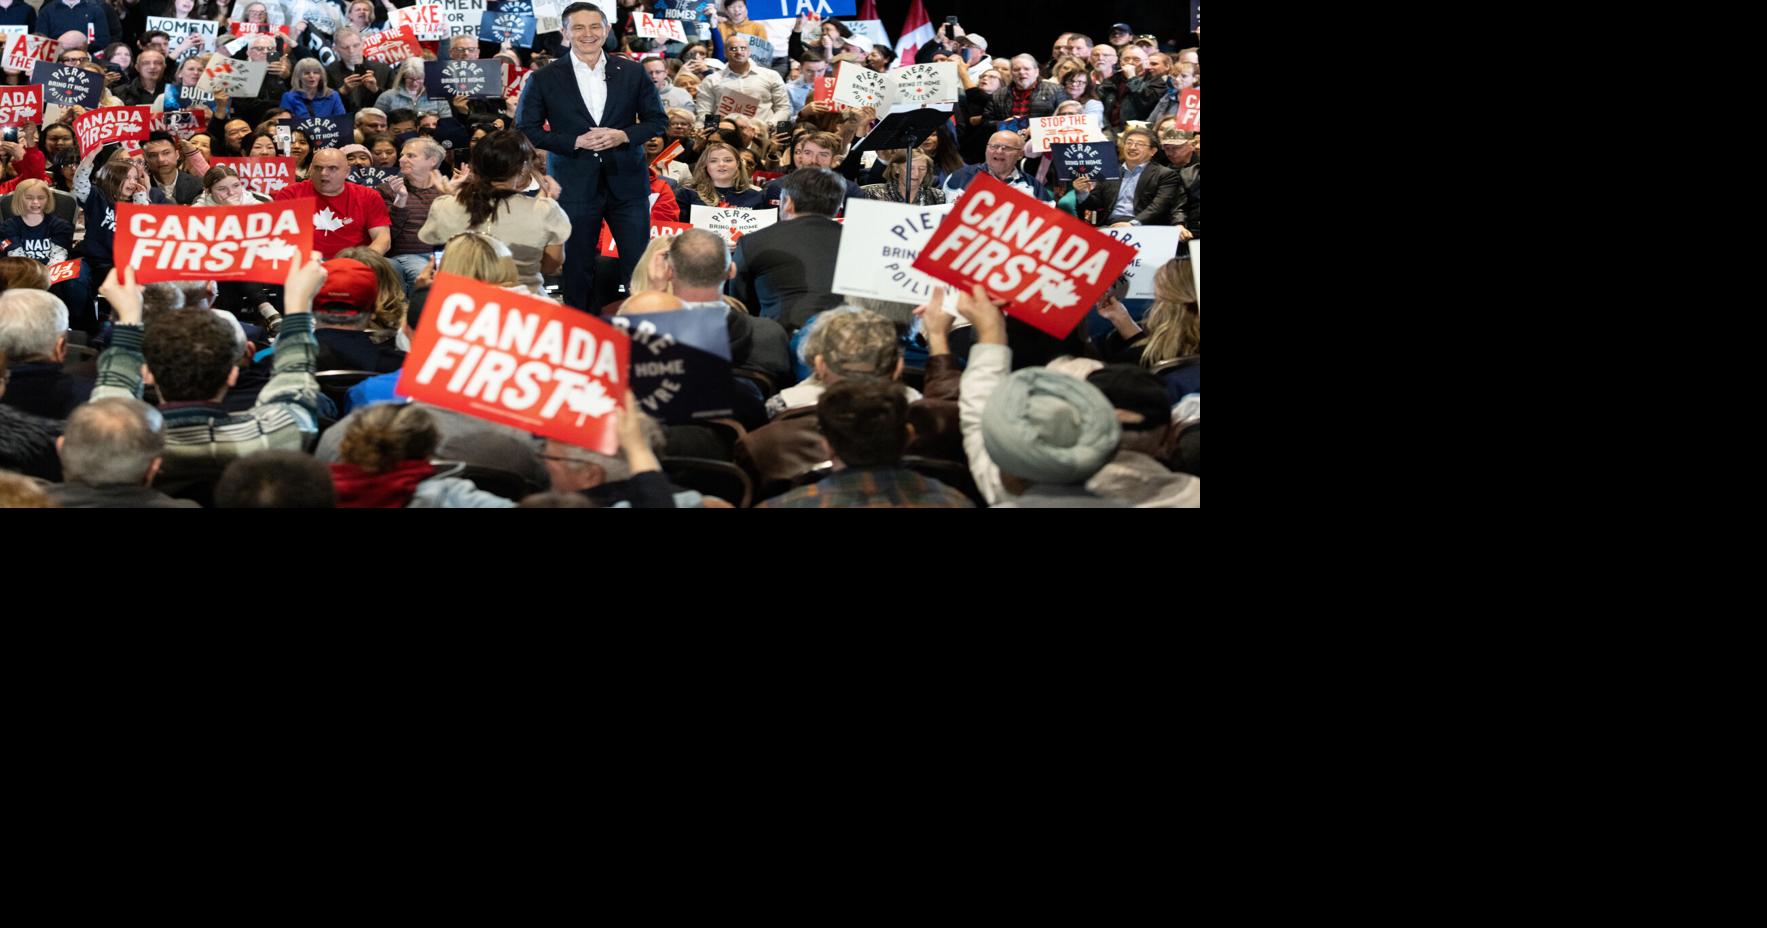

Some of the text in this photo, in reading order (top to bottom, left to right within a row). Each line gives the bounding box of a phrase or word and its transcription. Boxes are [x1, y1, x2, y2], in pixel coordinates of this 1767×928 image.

[665, 9, 697, 20] HOMES
[780, 0, 833, 16] TAX
[240, 23, 258, 33] STO
[385, 28, 404, 40] THE
[11, 34, 60, 62] AXE
[367, 44, 415, 64] CRIME
[9, 54, 33, 69] THE
[441, 61, 483, 76] PIERRE
[51, 67, 90, 84] PIERRE
[901, 64, 939, 80] PIERRE
[48, 80, 67, 89] BRING
[856, 71, 886, 90] PIERRE
[0, 90, 37, 107] ADA
[48, 87, 87, 103] POILIEVRE
[180, 86, 214, 101] BUILD
[76, 110, 143, 137] CANADA
[1040, 115, 1087, 128] STOP THE
[81, 122, 129, 154] FIRST
[1064, 143, 1099, 158] PIERRE
[711, 209, 757, 223] PIERRE
[129, 209, 300, 241] CANADA
[960, 190, 1110, 286] CANADA
[129, 238, 270, 272] FIRST
[882, 246, 918, 260] BRIN
[928, 224, 1066, 303] FIRST
[436, 293, 619, 384] CANADA
[634, 360, 685, 377] HOME
[416, 336, 589, 418] FIRST
